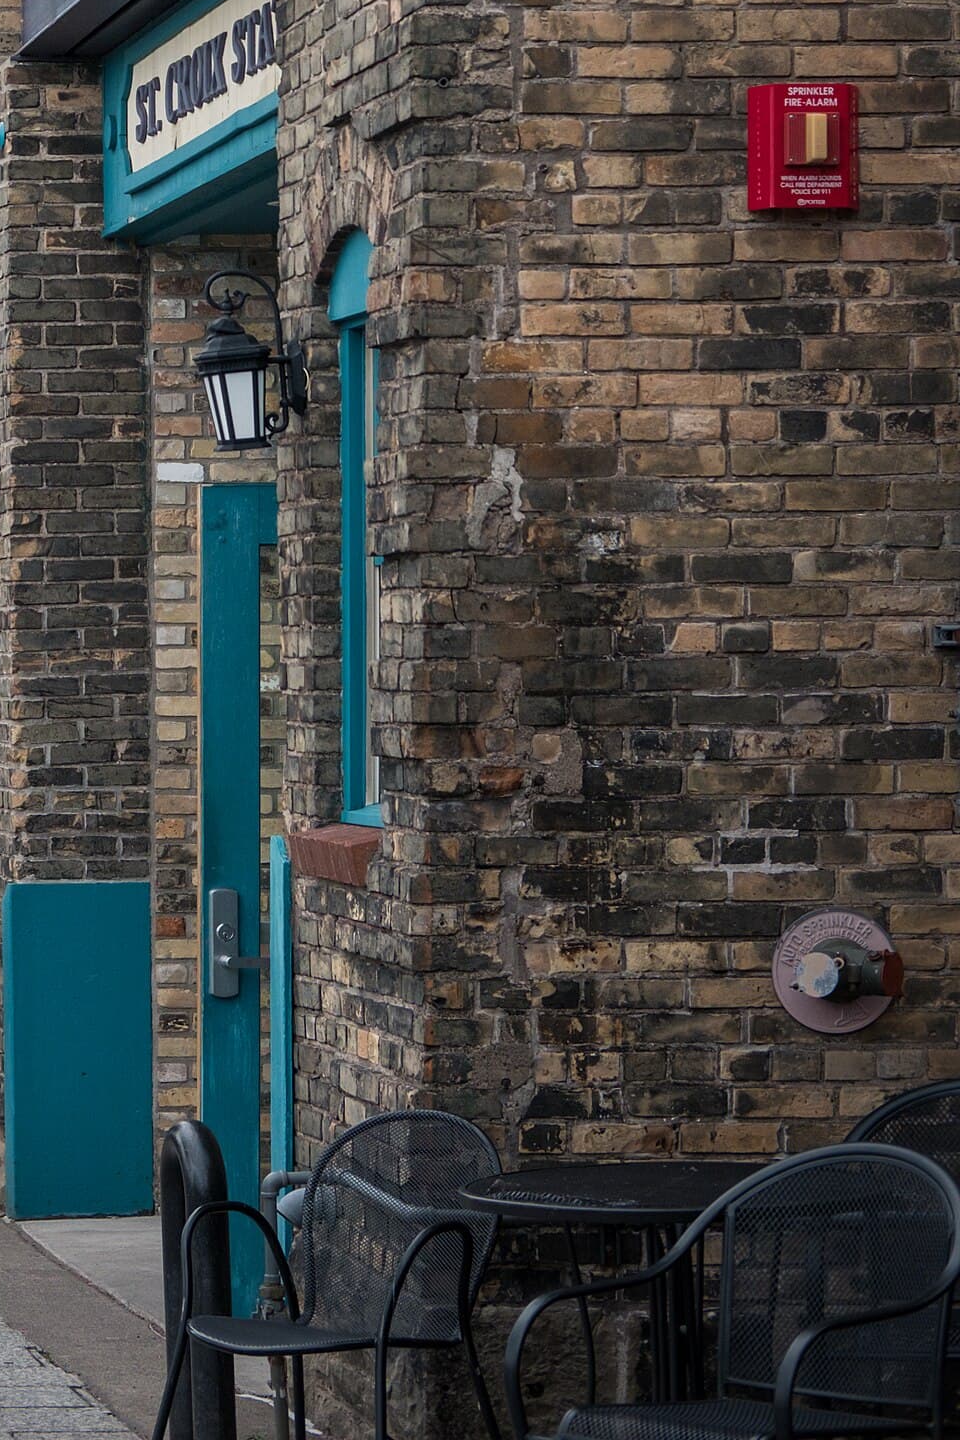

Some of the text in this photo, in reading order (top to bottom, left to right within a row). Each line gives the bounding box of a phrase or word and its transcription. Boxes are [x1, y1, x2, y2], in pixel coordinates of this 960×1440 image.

[136, 76, 163, 144] ST.
[165, 31, 228, 124] CROIX
[784, 98, 838, 107] FIRE-ALARM
[787, 86, 834, 96] SPRINKLER
[782, 935, 803, 968] AUTO
[802, 912, 873, 938] SPRINKLER
